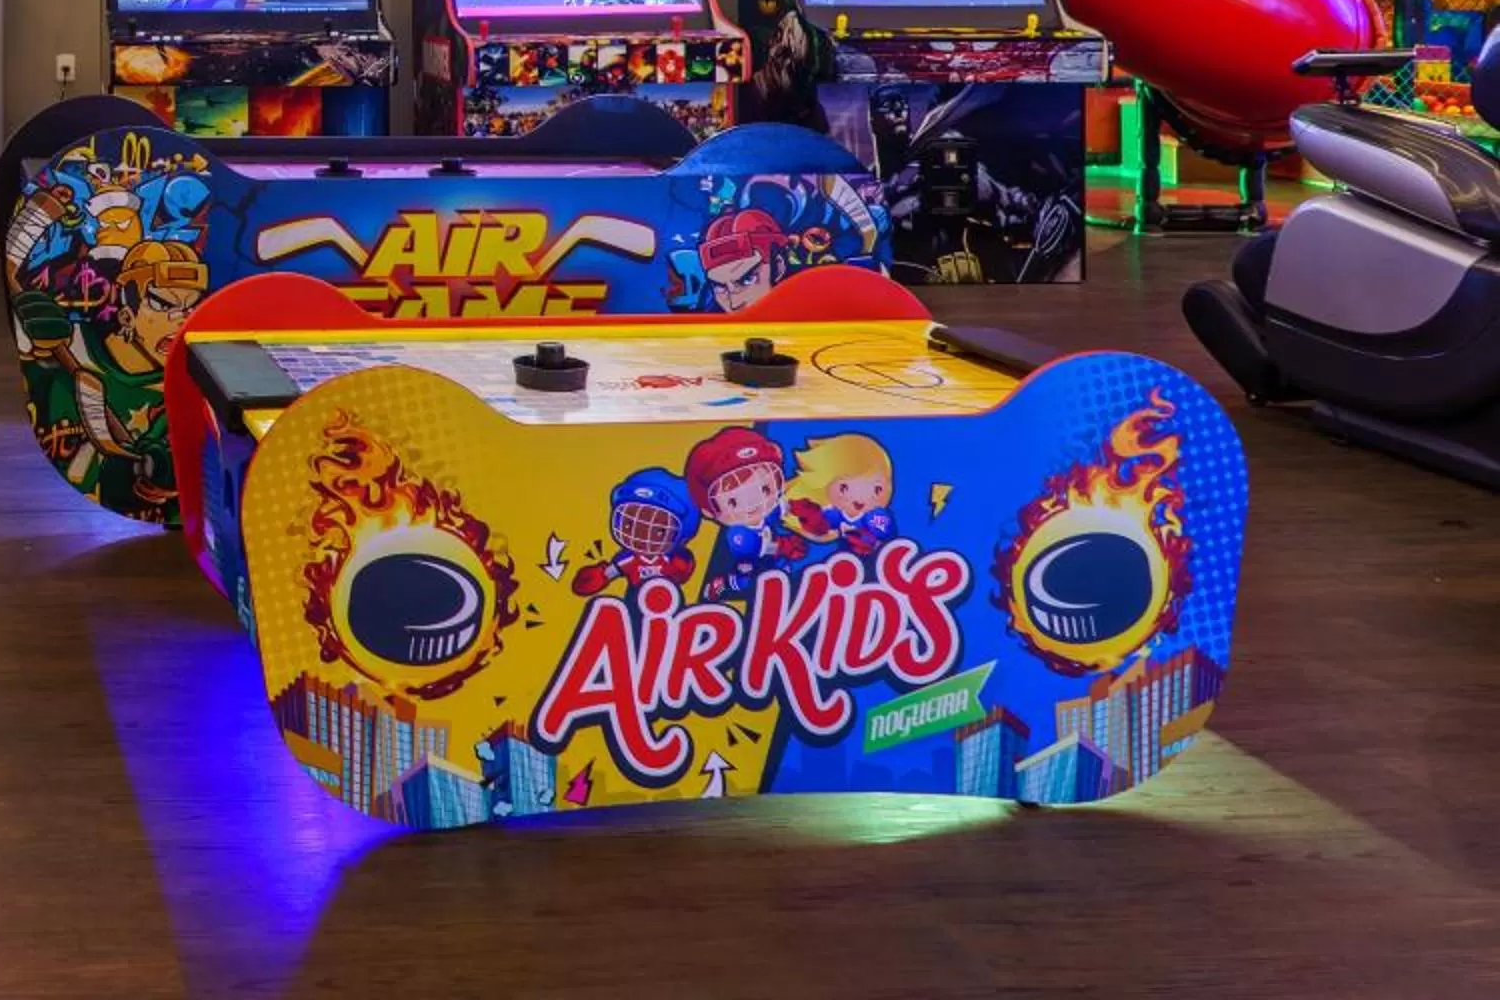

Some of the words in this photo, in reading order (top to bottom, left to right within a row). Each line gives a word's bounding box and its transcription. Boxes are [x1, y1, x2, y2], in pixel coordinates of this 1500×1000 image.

[362, 209, 550, 279] AIR
[534, 576, 742, 774] AIR
[740, 538, 970, 735] KIDS
